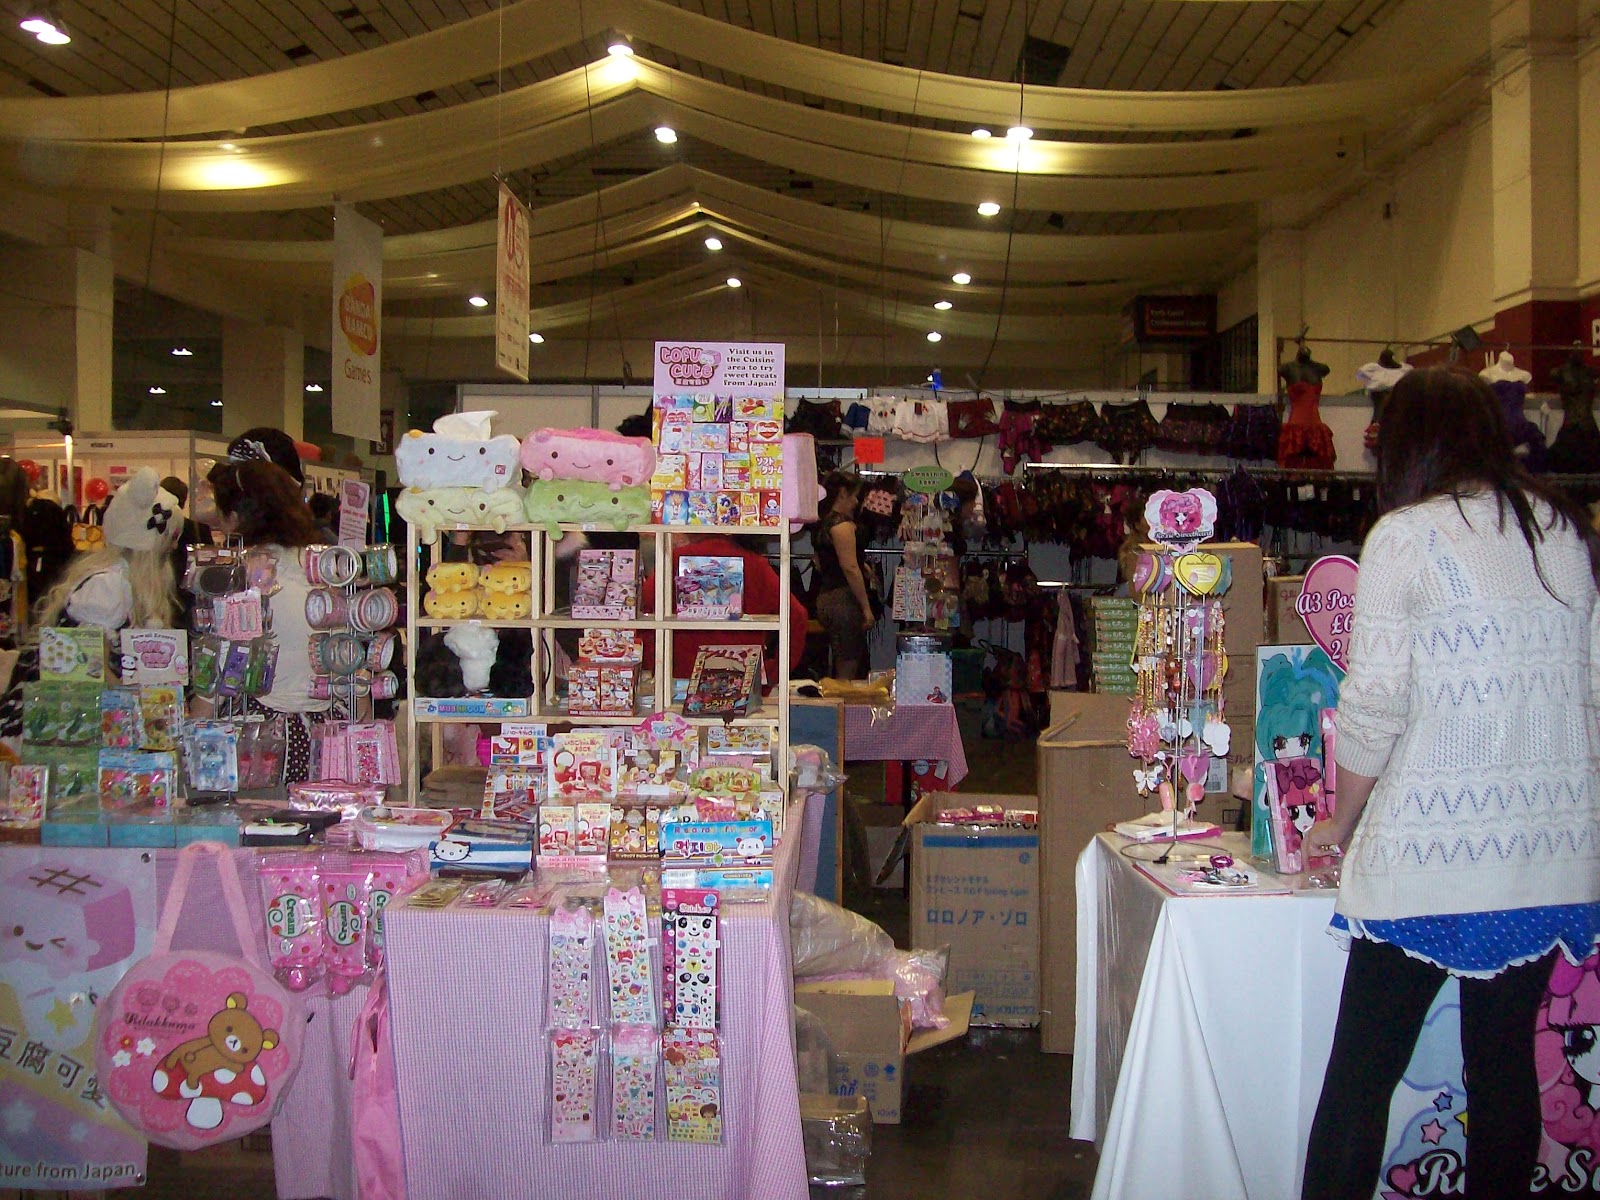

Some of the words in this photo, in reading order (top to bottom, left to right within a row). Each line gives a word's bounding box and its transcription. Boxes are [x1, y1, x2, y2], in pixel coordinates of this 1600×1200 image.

[344, 358, 372, 385] Games
[286, 898, 297, 935] Cream
[338, 904, 348, 941] Cream
[37, 1160, 78, 1179] from
[84, 1164, 135, 1181] Japan
